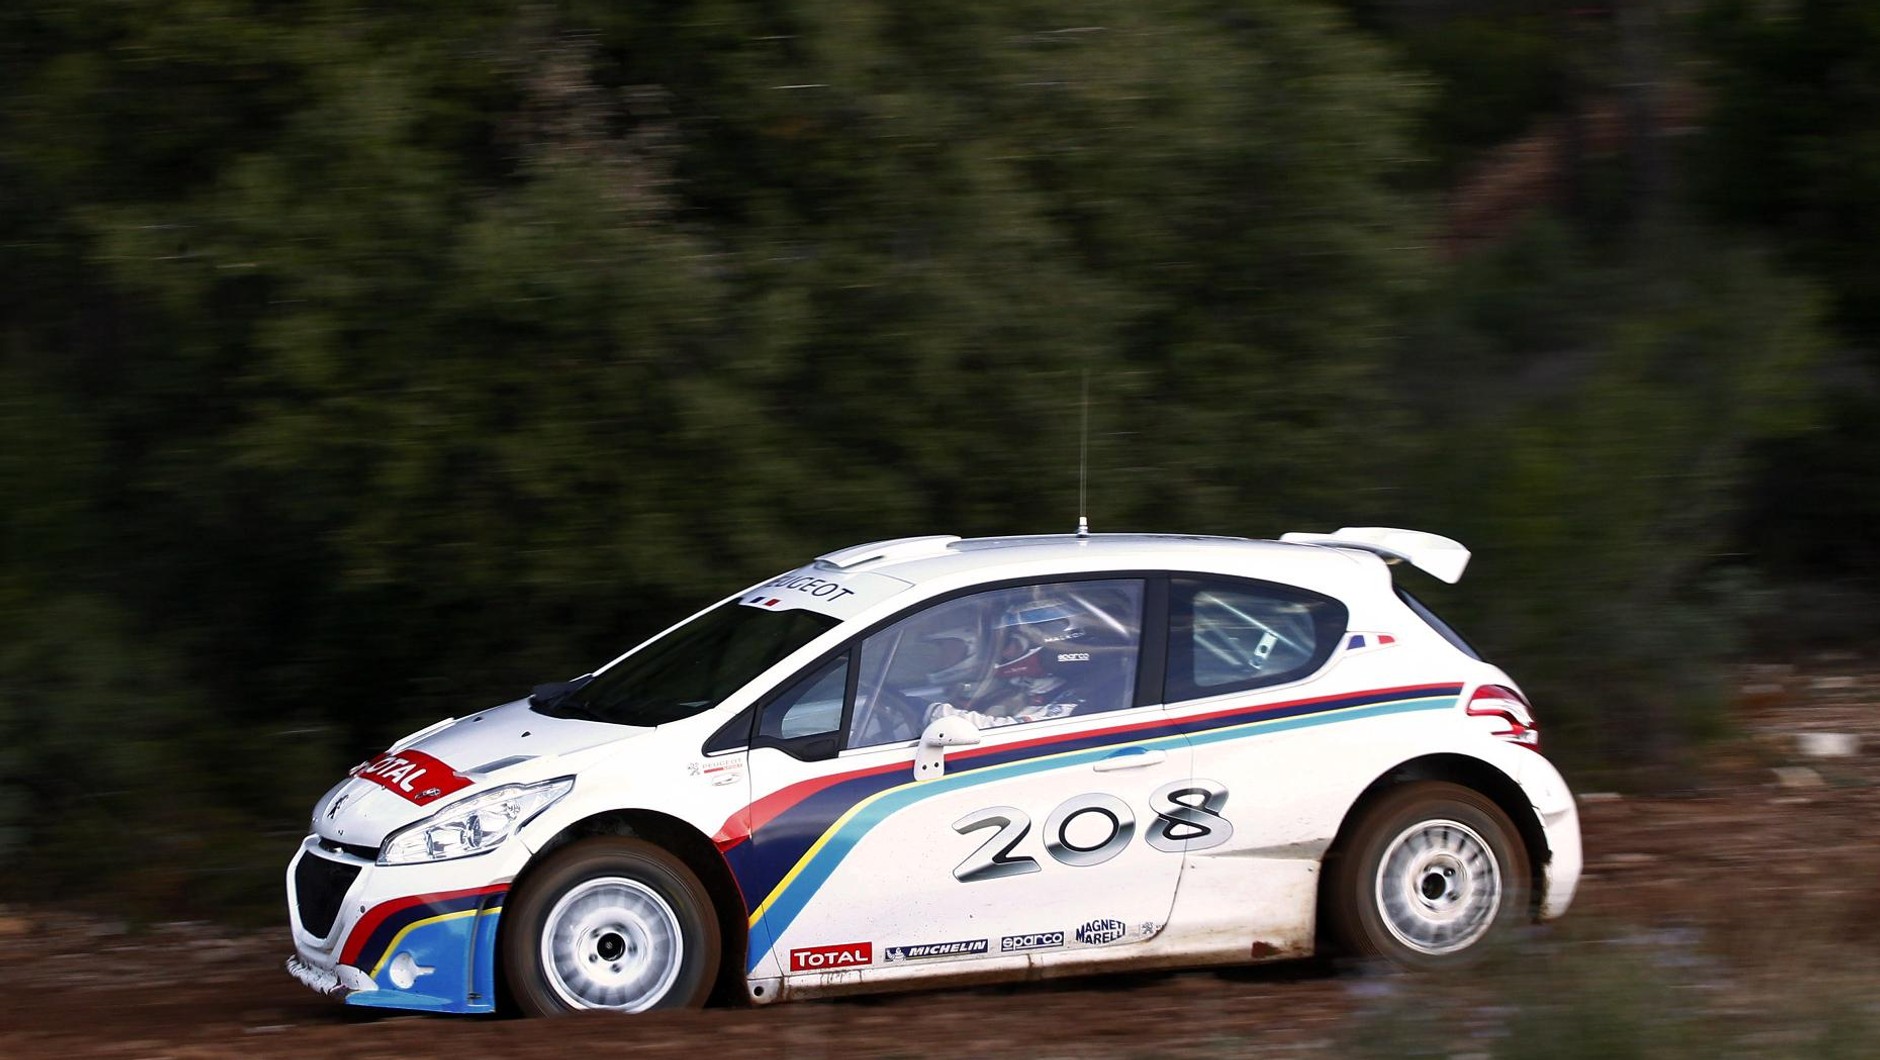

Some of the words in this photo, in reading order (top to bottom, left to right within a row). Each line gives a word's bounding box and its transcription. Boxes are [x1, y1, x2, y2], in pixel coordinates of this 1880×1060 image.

[352, 755, 427, 794] OTAL
[951, 778, 1234, 883] 208
[908, 940, 987, 957] MICHELIN
[1002, 933, 1064, 952] sparco
[794, 949, 869, 968] TOTAL
